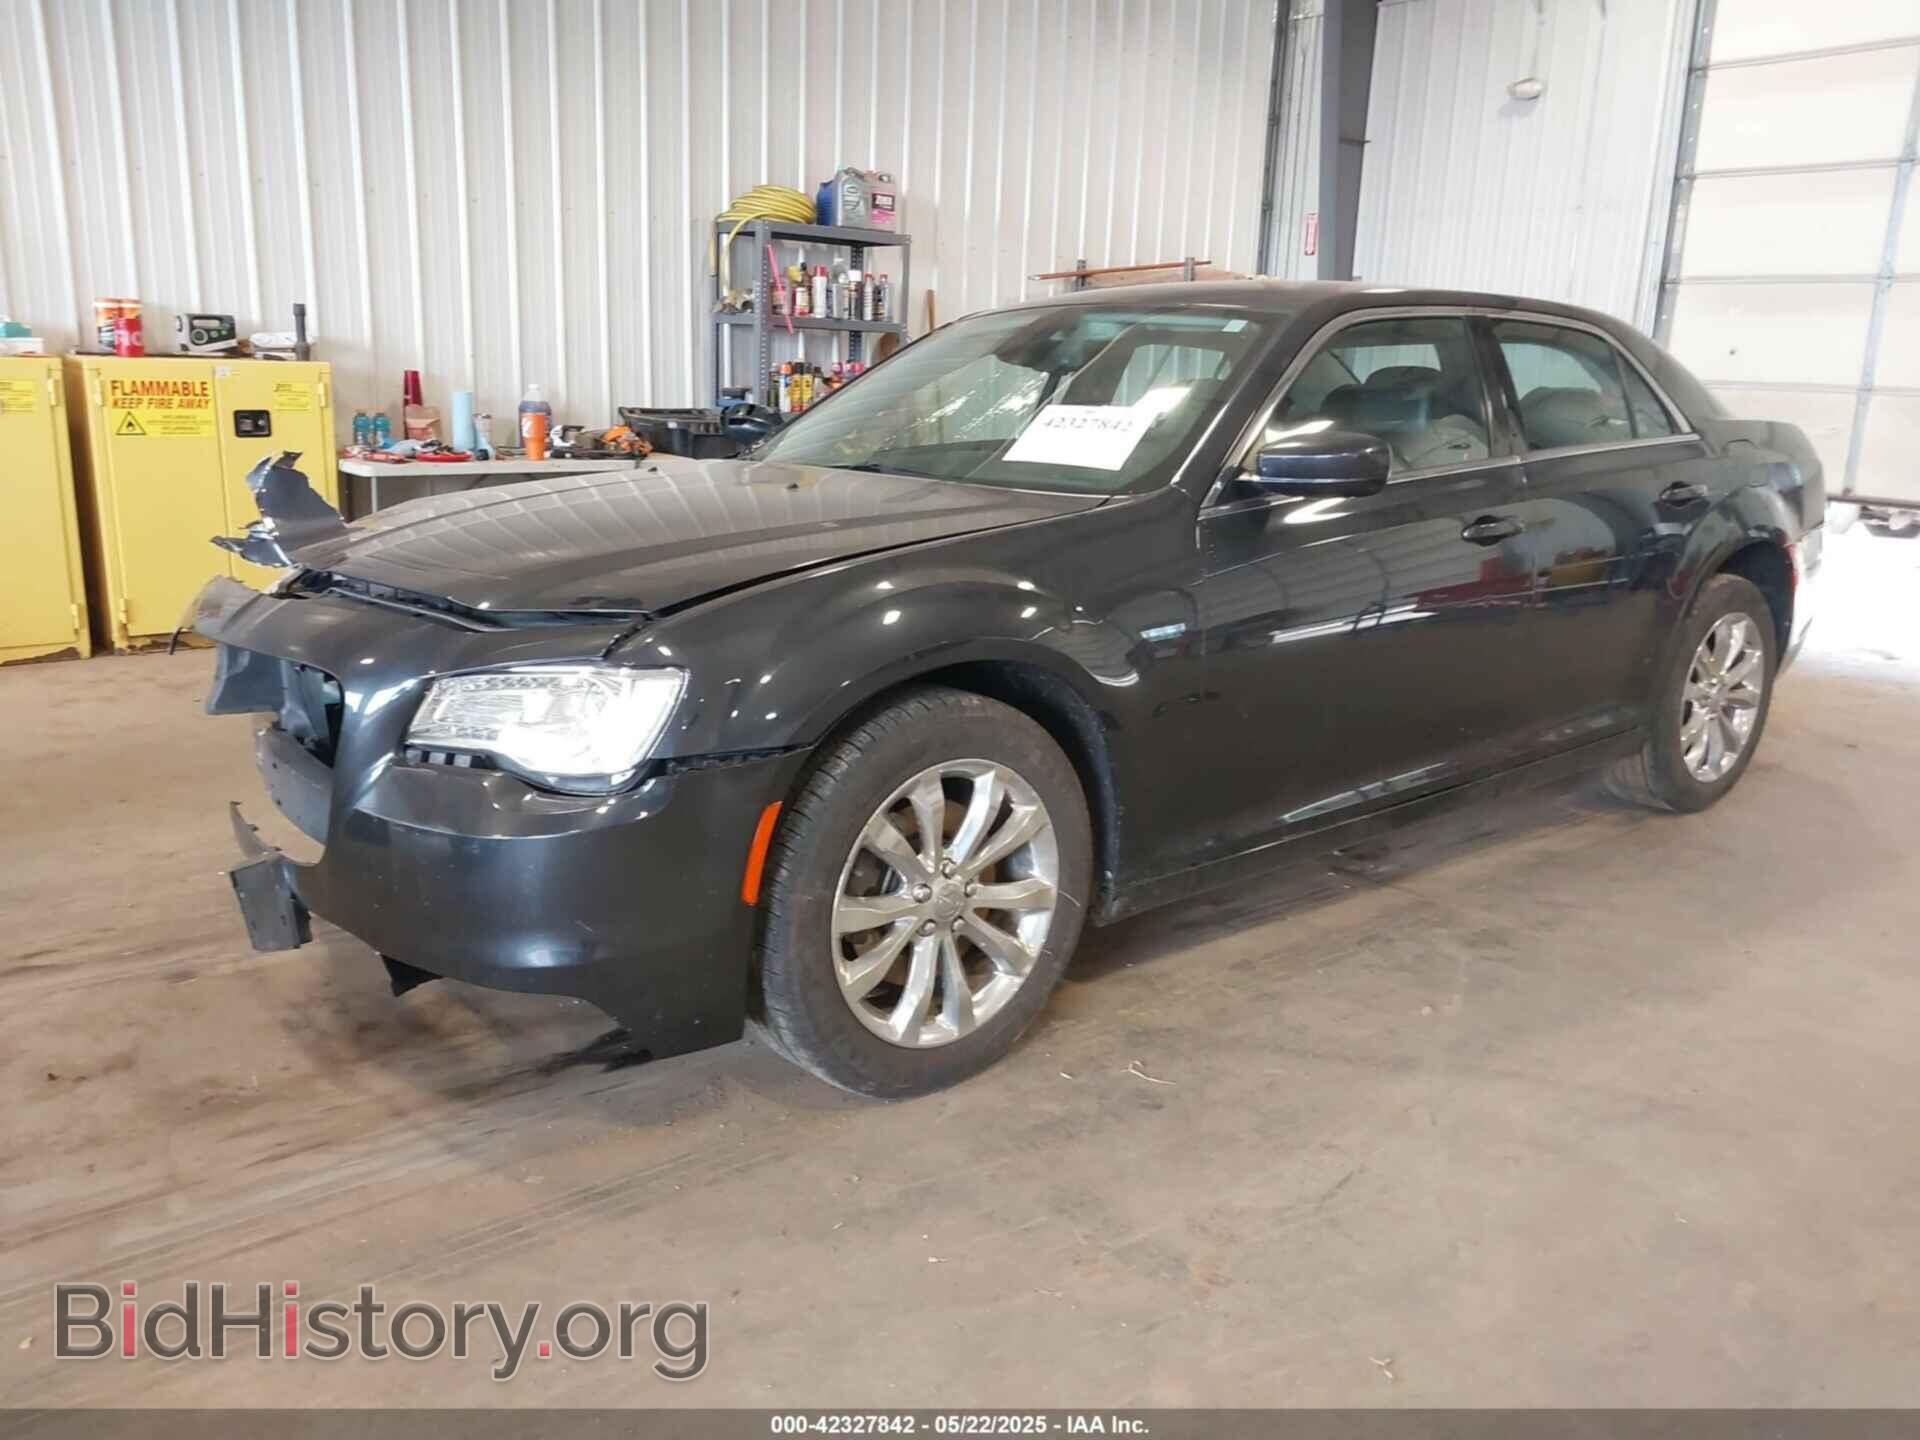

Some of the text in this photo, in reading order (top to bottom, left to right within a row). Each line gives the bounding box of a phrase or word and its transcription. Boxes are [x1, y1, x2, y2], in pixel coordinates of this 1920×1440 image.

[110, 379, 209, 396] FLAMMABLE
[112, 397, 211, 409] KEEP FIRE AWAY
